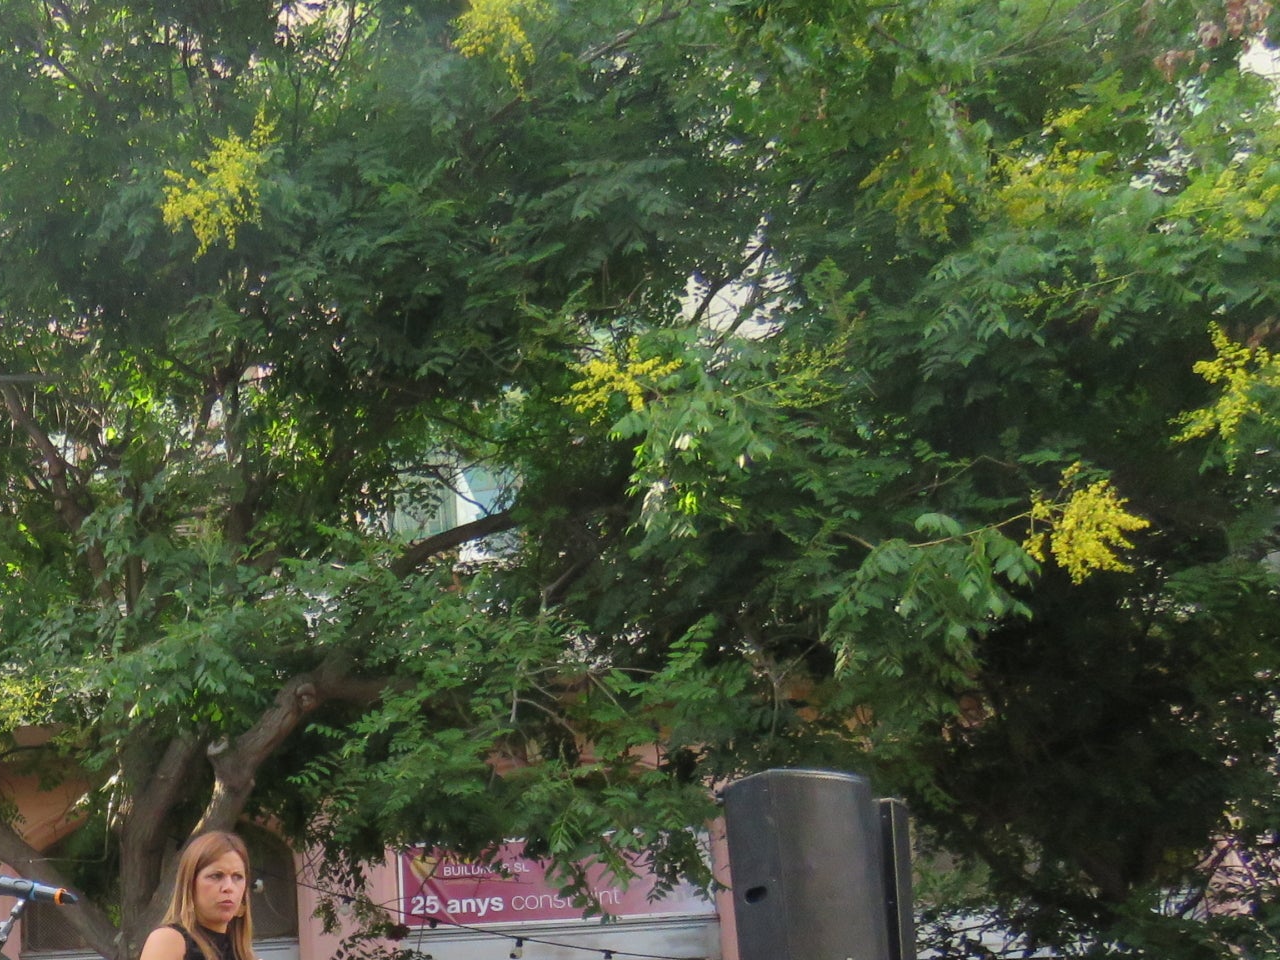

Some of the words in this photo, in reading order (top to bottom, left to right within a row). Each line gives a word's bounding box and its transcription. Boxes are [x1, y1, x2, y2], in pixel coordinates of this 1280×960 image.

[514, 862, 530, 873] SL
[411, 896, 440, 915] 25
[447, 896, 504, 917] anys
